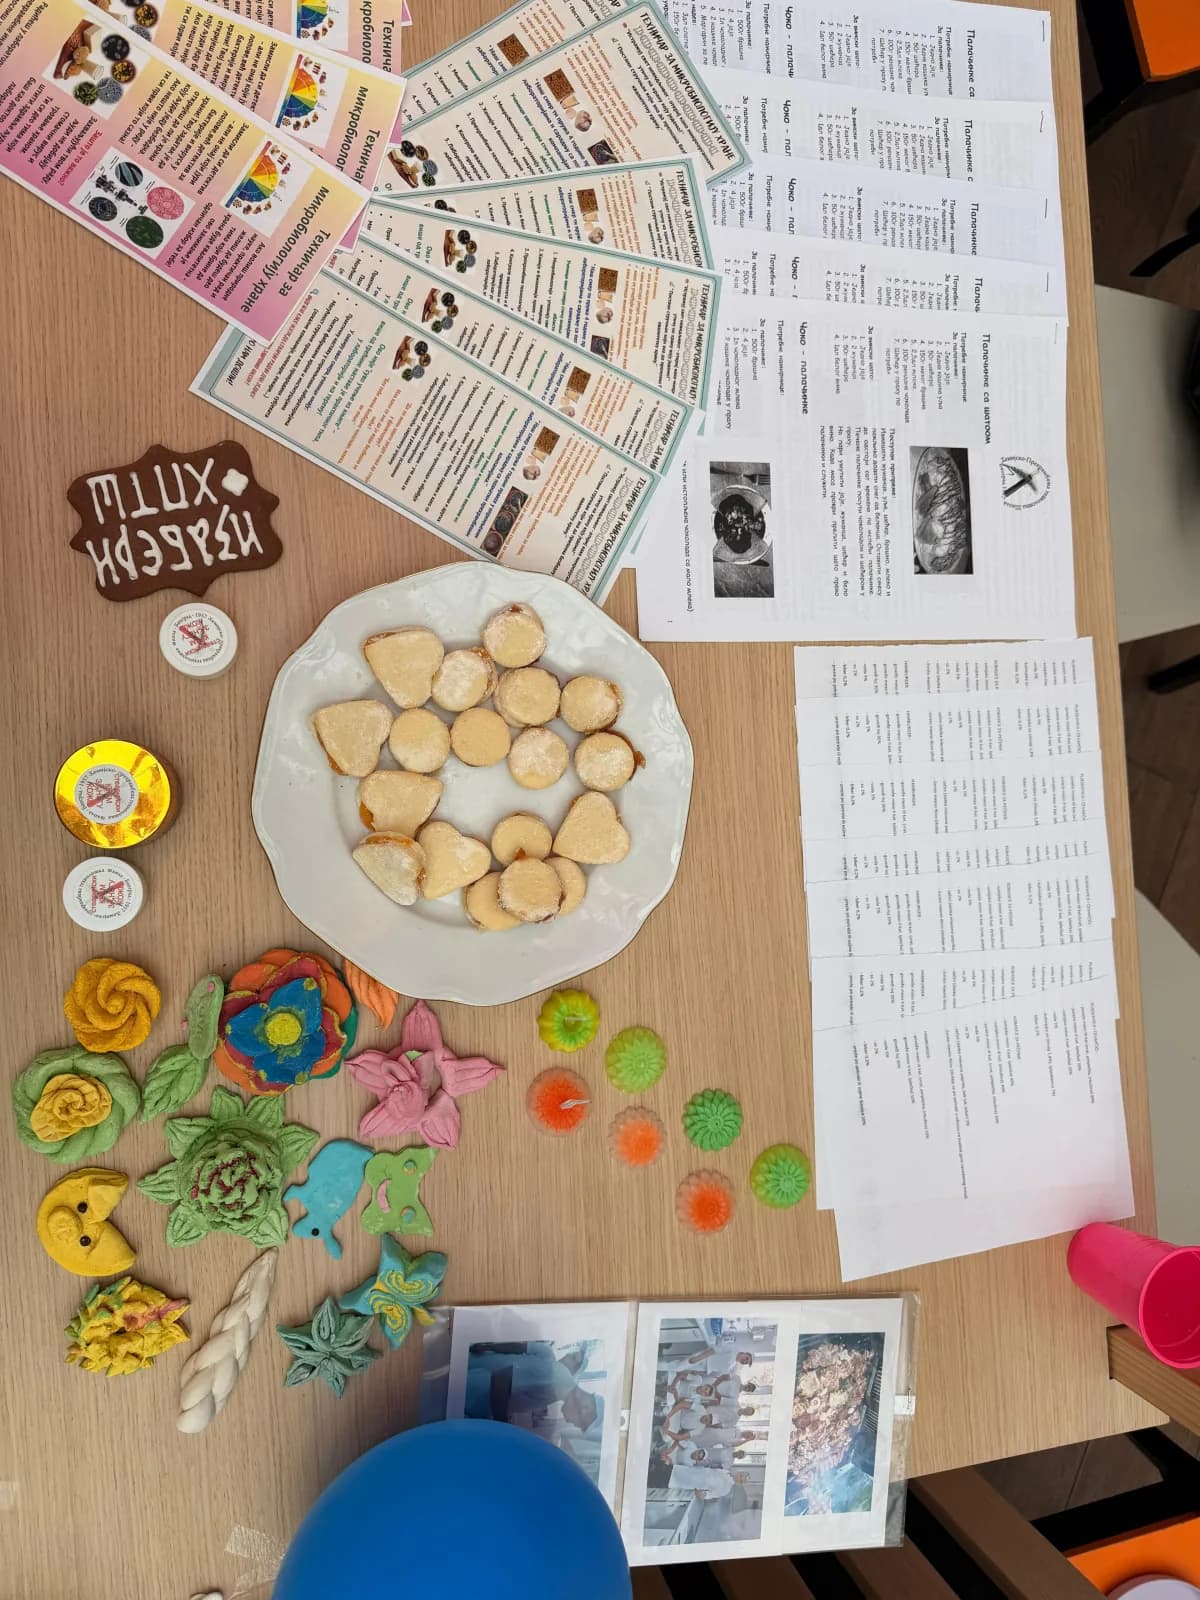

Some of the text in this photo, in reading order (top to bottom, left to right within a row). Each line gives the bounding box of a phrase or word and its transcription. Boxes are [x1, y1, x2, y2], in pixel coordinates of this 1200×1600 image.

[785, 6, 794, 31] Чоко
[966, 30, 976, 97] Палачинке са
[154, 89, 172, 112] нешто
[169, 78, 181, 92] Ако
[638, 11, 736, 161] ТЕХНИЧАР ЗА МИКРОБИОЛОГИЈУ ХРАНЕ
[117, 70, 171, 144] ти си први који то сазна!
[137, 82, 192, 157] коју људи једу безбедна.
[144, 109, 158, 125] није
[148, 89, 200, 162] откријеш да ли је храна
[190, 106, 217, 141] бактерије
[783, 100, 792, 123] Чоко
[131, 127, 146, 145] реду
[157, 95, 211, 169] храни! Твој задатак је да
[964, 120, 973, 172] Палачинке
[173, 142, 192, 167] вирусе
[183, 143, 205, 174] детектив
[188, 123, 234, 186] али не онај који јури
[196, 122, 249, 196] Замисли да си детектив
[178, 172, 185, 181] за
[675, 170, 689, 207] ТЕХНИЧАР
[683, 208, 693, 219] ЗА
[788, 178, 796, 202] Чоко
[212, 240, 226, 256] који
[241, 232, 258, 252] науке,
[259, 184, 333, 282] микробиологију
[970, 202, 979, 256] Палачинке
[195, 271, 204, 281] да
[200, 253, 218, 274] брине
[202, 229, 247, 289] желиш да будеш део
[220, 249, 246, 283] практичан
[220, 241, 265, 301] Ако волиш природне
[278, 226, 331, 298] Техничар за
[791, 256, 800, 280] Чоко
[212, 280, 224, 294] рад
[236, 276, 268, 314] хране
[799, 321, 808, 414] Чоко палачинке
[981, 334, 992, 444] Палачинке са шатоом
[86, 458, 218, 524] ХПТШ
